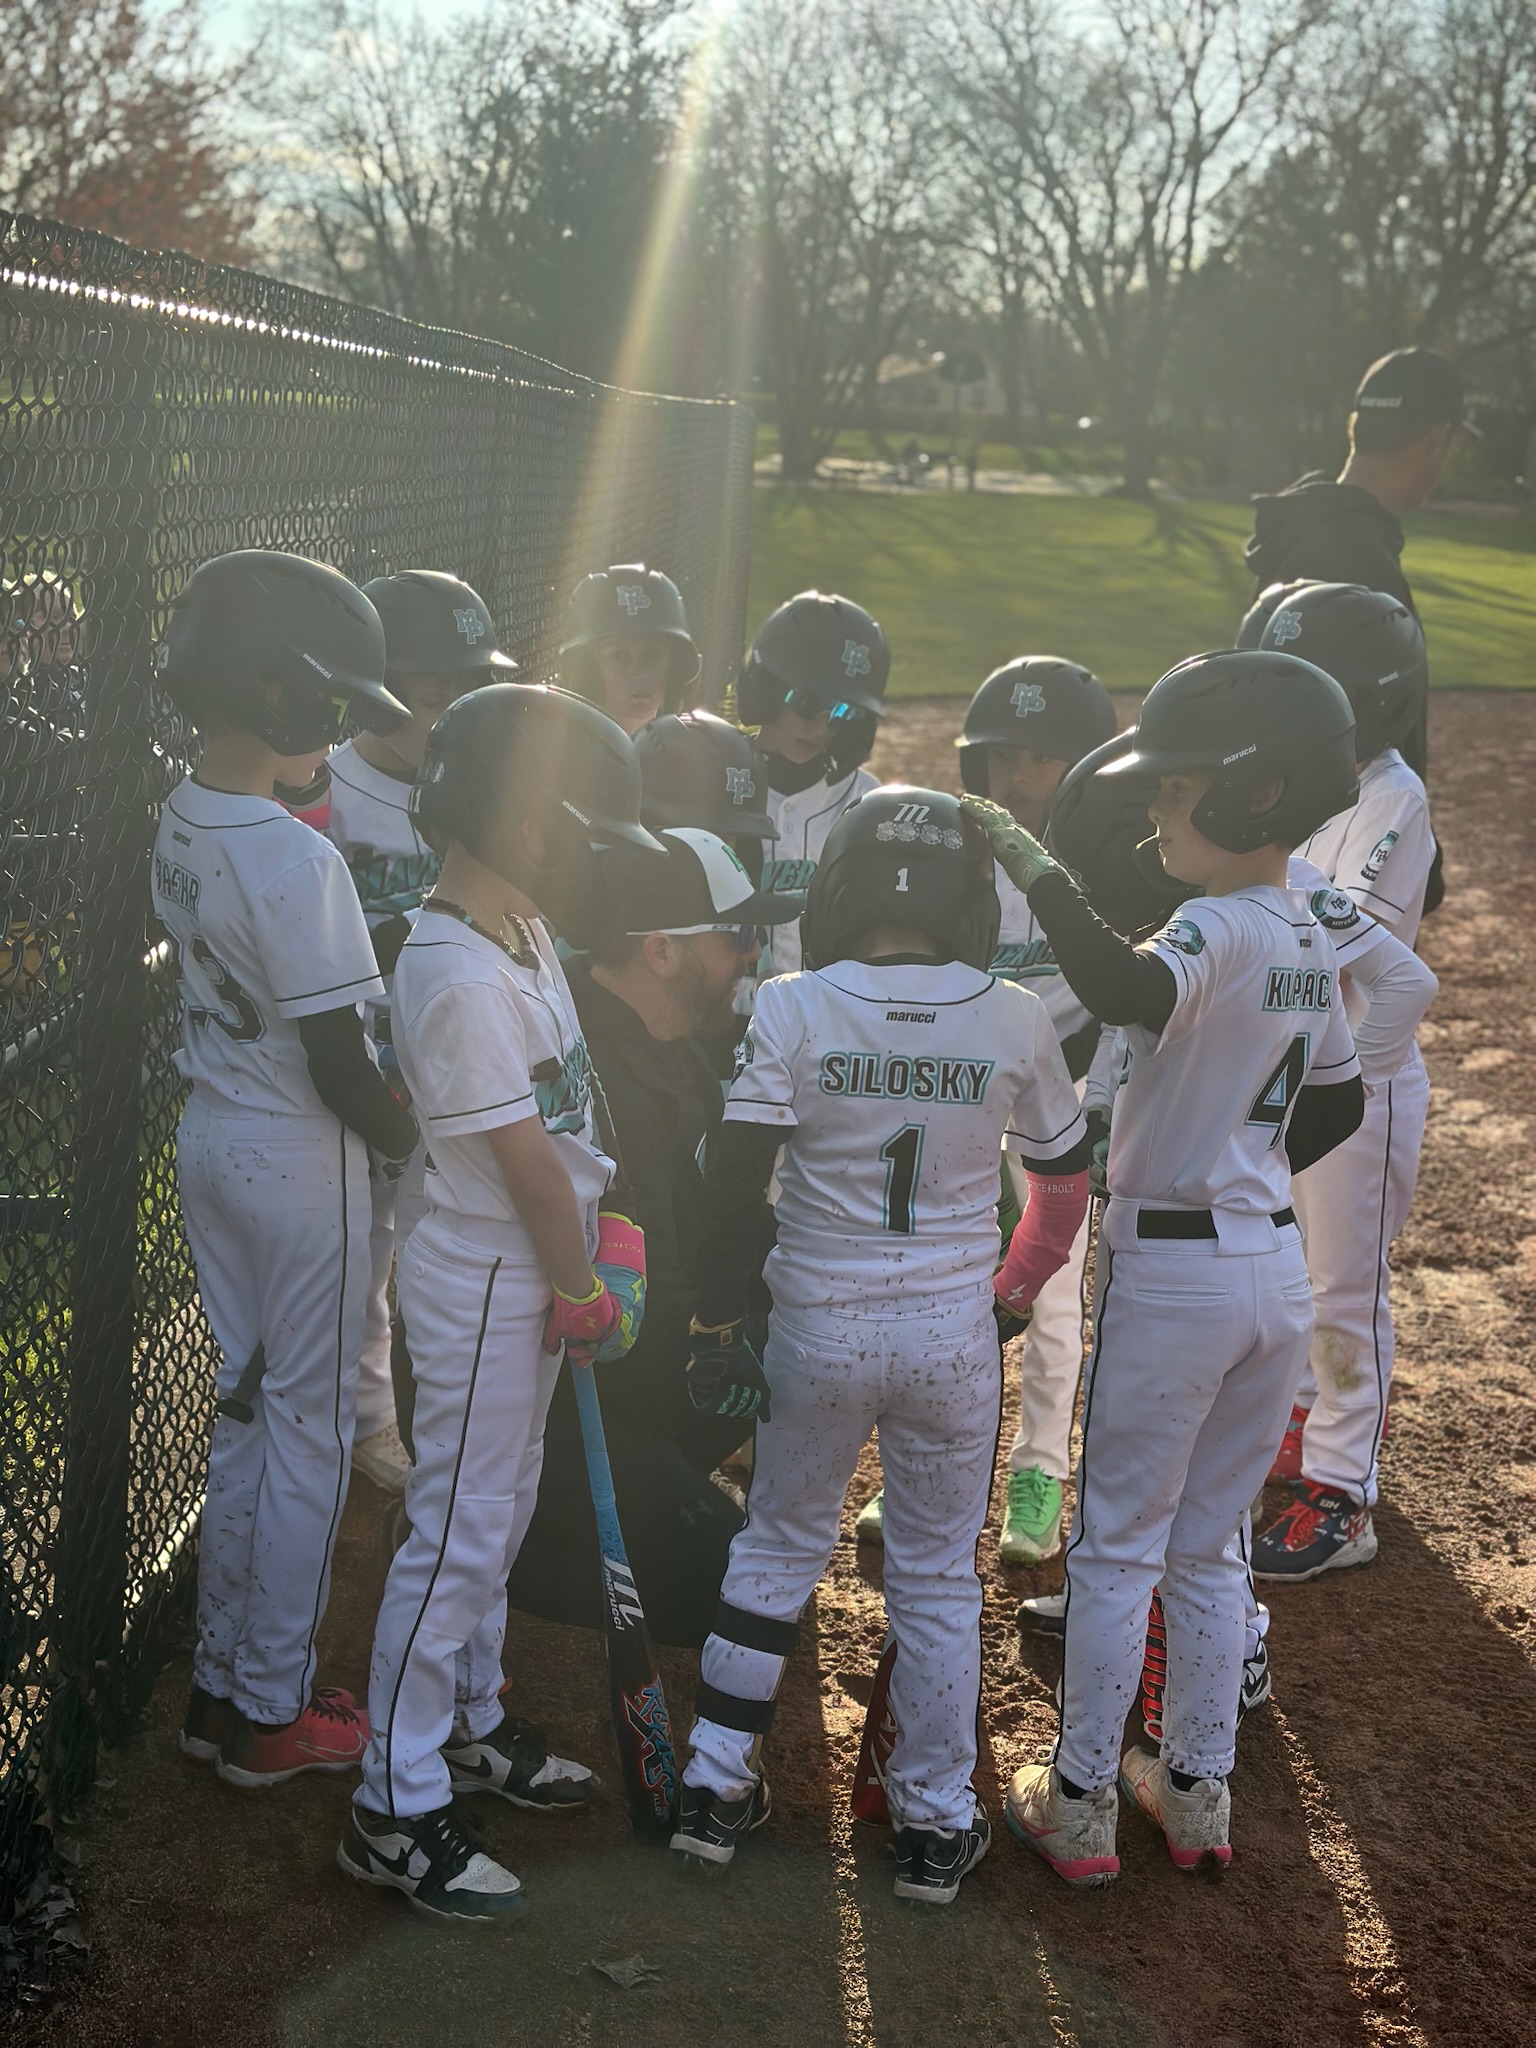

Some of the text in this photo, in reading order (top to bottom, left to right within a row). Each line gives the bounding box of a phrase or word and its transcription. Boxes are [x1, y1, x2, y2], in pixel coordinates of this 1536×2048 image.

[453, 608, 485, 644] MP
[302, 653, 333, 680] marucci
[1222, 744, 1257, 766] marucci
[726, 767, 755, 804] MP
[562, 800, 592, 826] marucci
[895, 867, 909, 892] 1
[886, 1010, 936, 1024] marucci
[818, 1051, 995, 1104] SILOSKY
[1244, 1032, 1311, 1150] 4
[878, 1122, 926, 1234] 1
[604, 1567, 625, 1632] marucci
